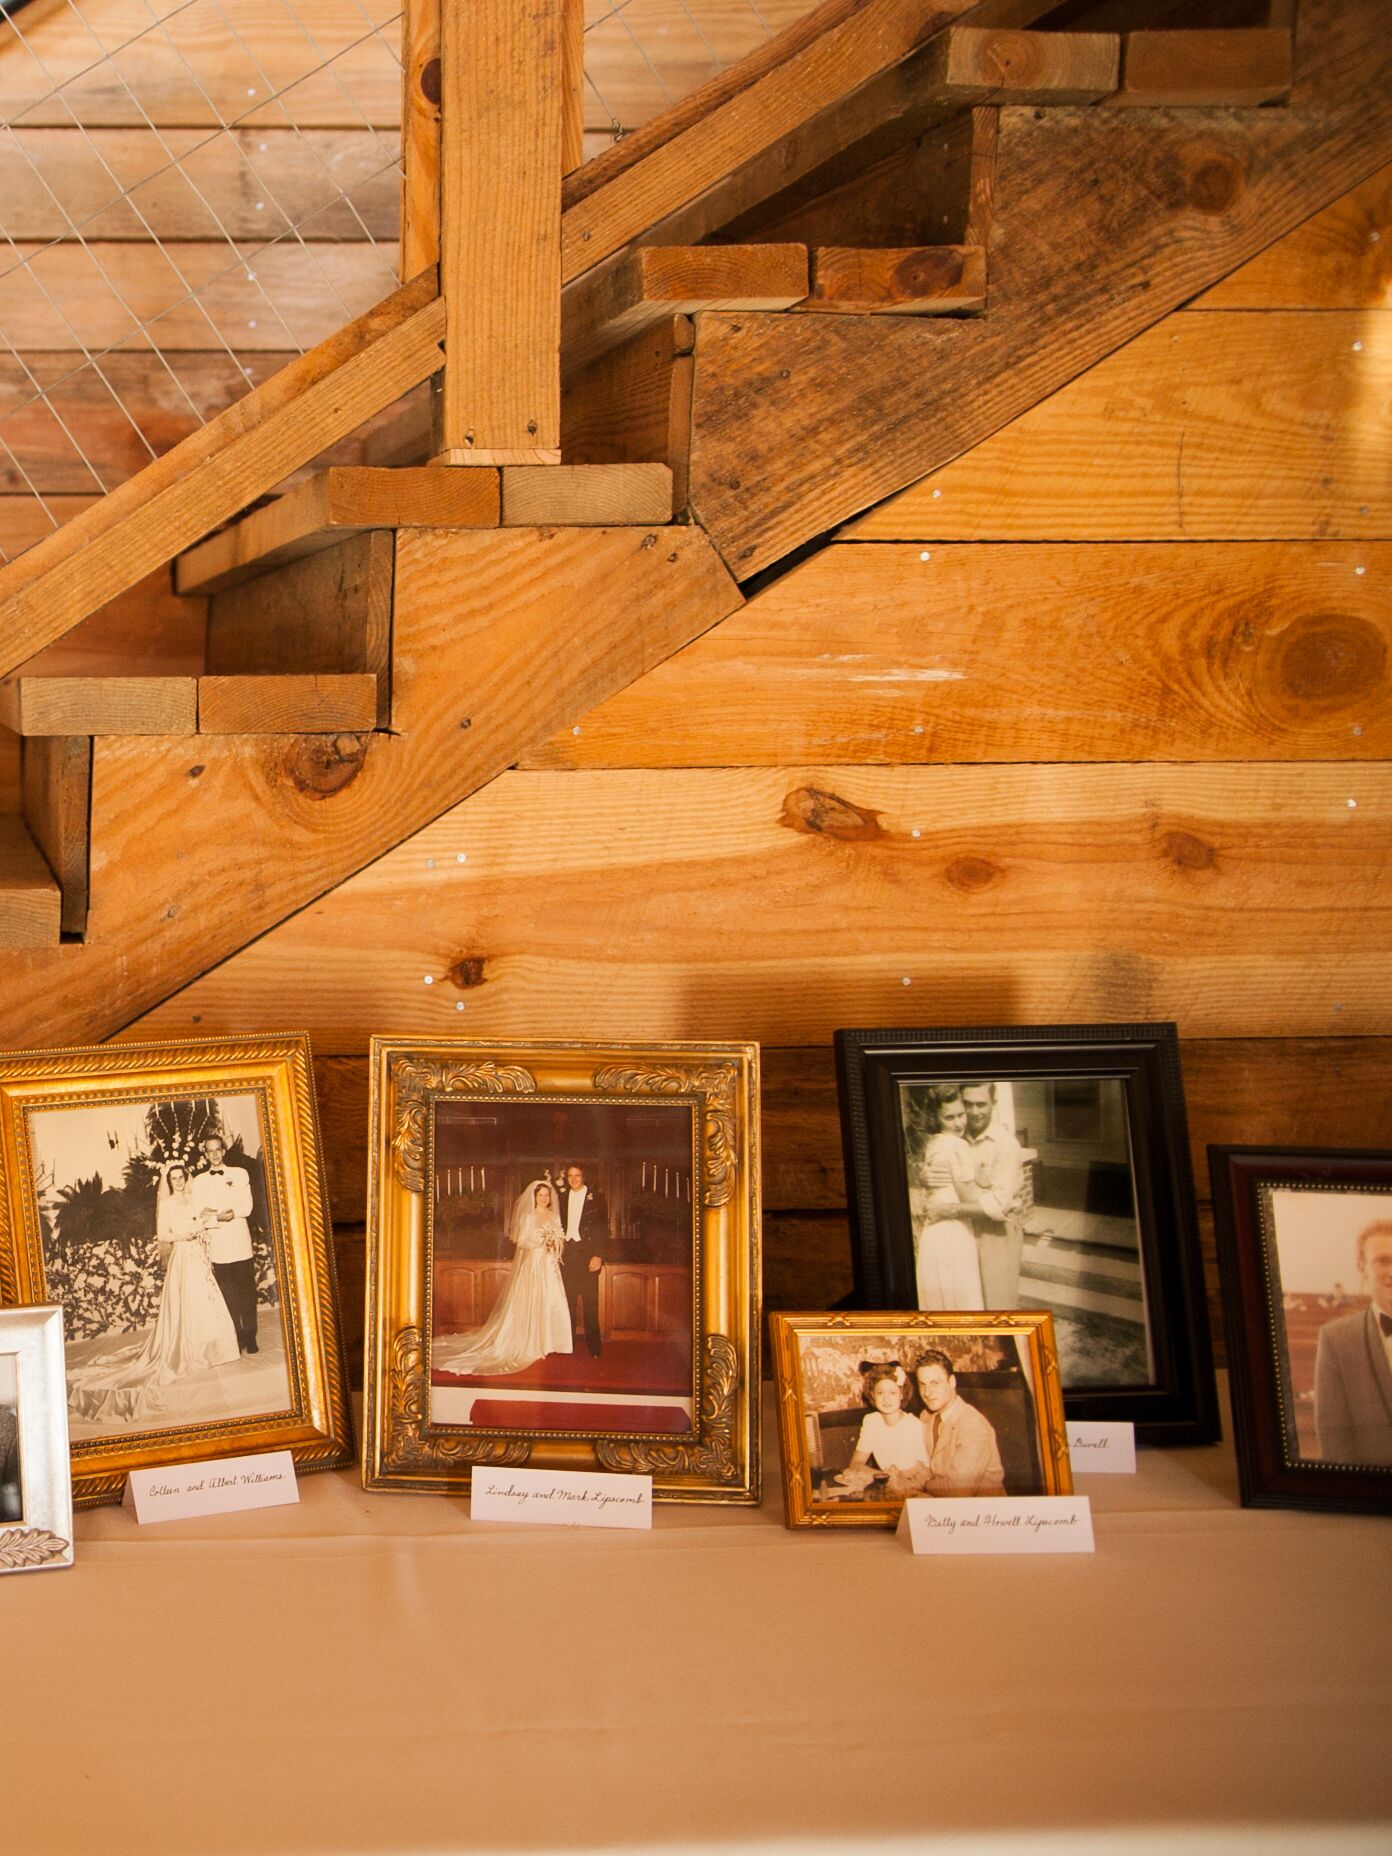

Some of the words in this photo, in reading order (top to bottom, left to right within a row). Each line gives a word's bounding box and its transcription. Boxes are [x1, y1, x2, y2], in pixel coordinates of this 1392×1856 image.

[149, 1485, 180, 1497] Colleen
[187, 1480, 204, 1493] and
[209, 1475, 238, 1489] Albert
[241, 1472, 285, 1484] Williams
[485, 1484, 529, 1505] Lindsay
[532, 1488, 554, 1499] and
[557, 1489, 589, 1501] Mark
[591, 1491, 644, 1509] Lipscomb
[925, 1514, 956, 1534] Betty
[960, 1514, 979, 1527] and
[984, 1514, 1020, 1527] Howell
[1025, 1514, 1079, 1533] Lipscomb
